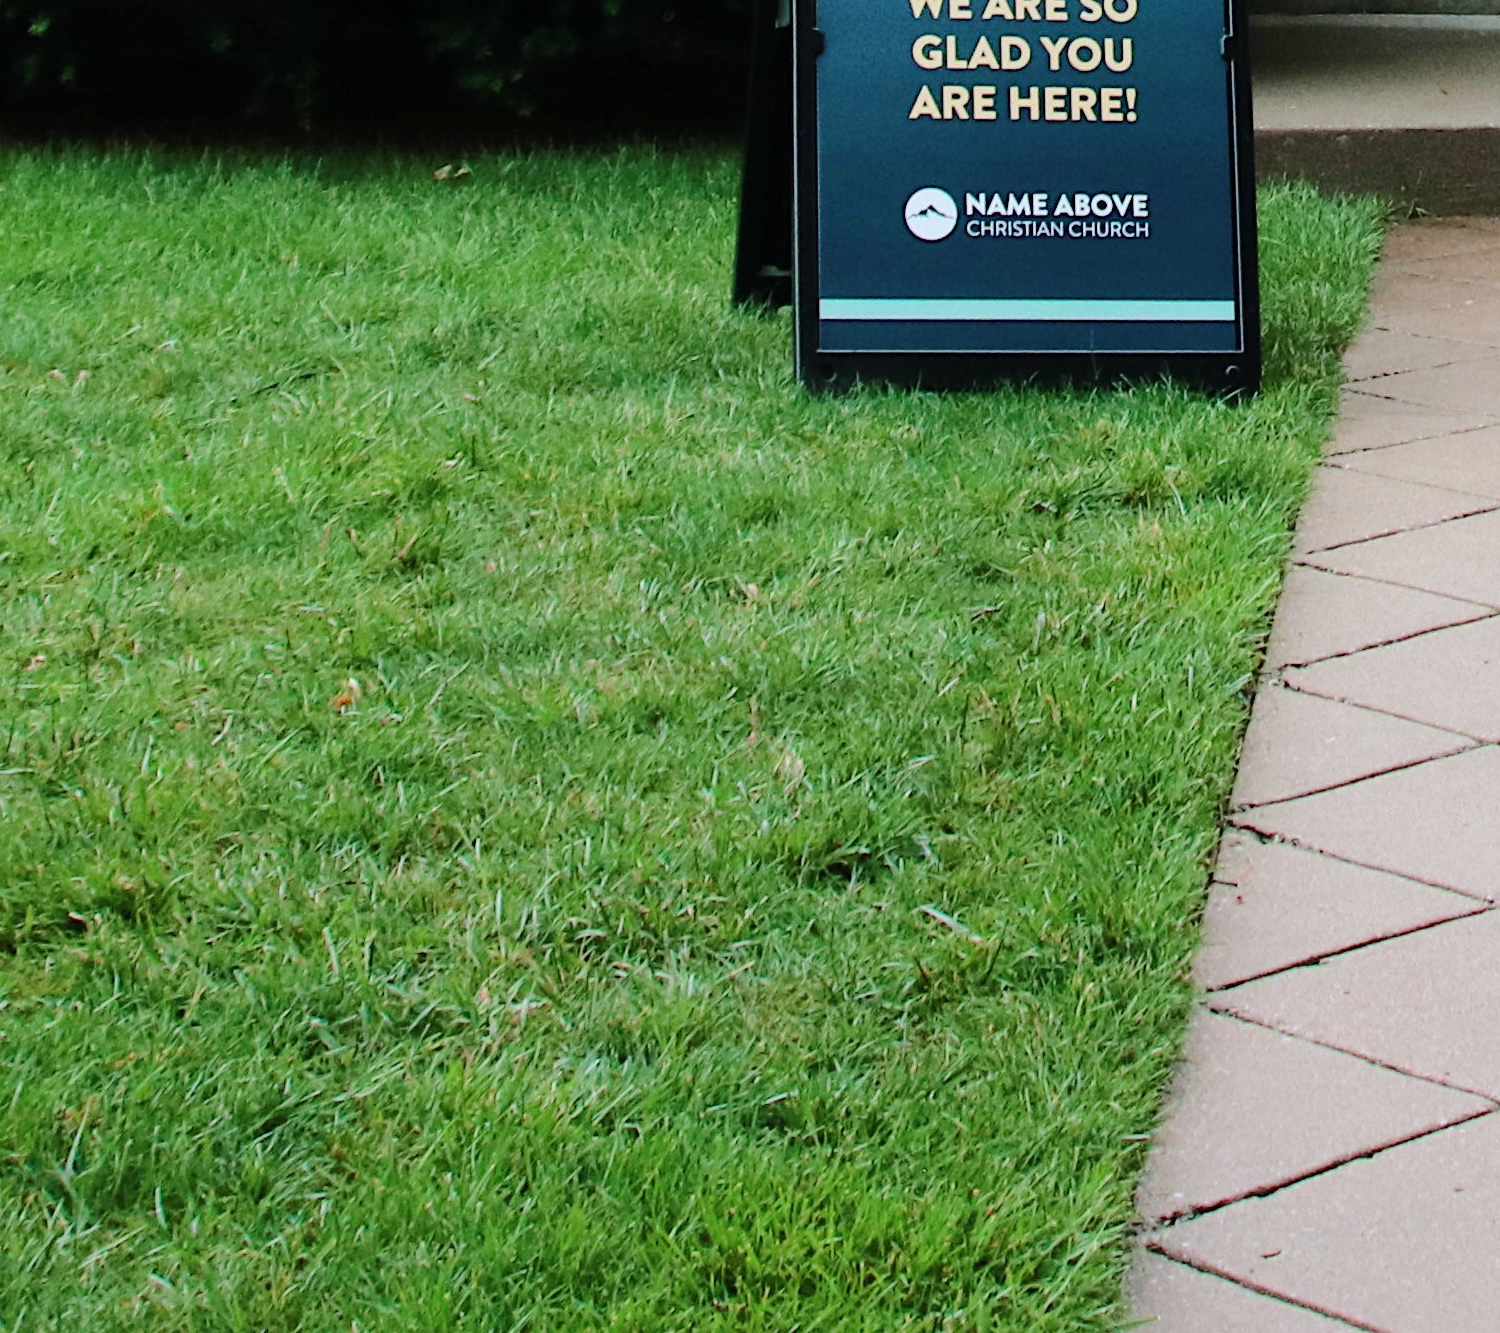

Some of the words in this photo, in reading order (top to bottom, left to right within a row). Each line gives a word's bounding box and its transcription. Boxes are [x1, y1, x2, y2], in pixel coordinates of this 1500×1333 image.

[912, 34, 1031, 70] GLAD
[1040, 36, 1133, 72] YOU
[908, 85, 997, 120] ARE
[1009, 86, 1137, 123] HERE!
[965, 192, 1049, 216] NAME
[1053, 193, 1149, 217] ABOVE
[966, 219, 1064, 237] CHRISTIAN
[1068, 220, 1149, 238] CHURCH
